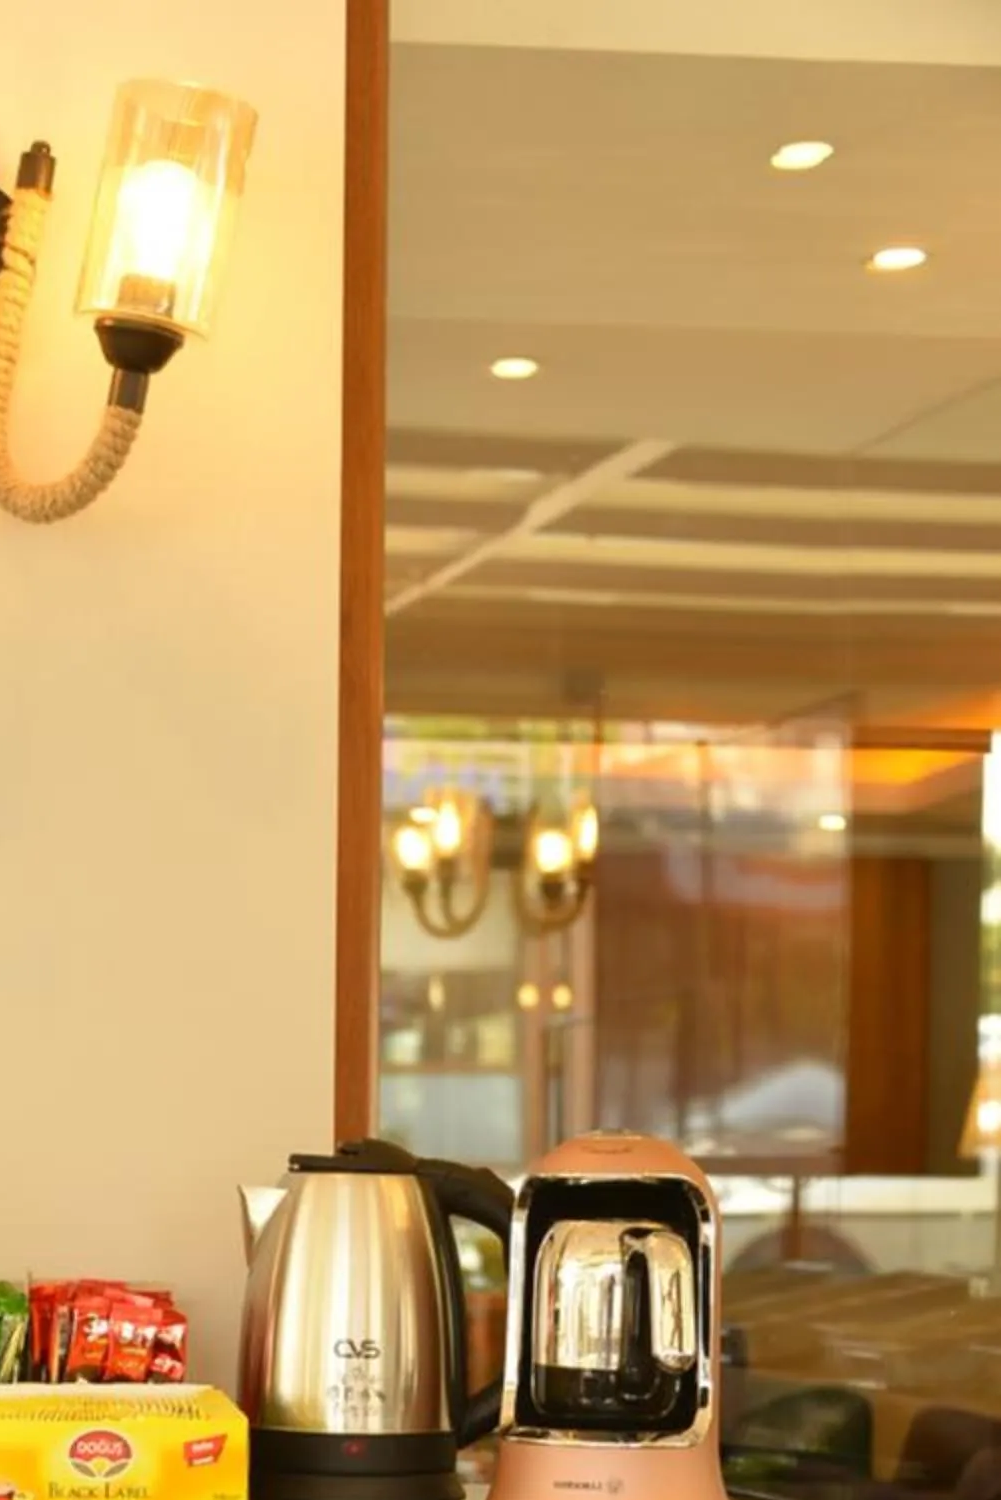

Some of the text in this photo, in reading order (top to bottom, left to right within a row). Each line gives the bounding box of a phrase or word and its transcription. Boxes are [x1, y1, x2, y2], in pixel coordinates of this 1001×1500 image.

[333, 1338, 381, 1360] CVS
[48, 1481, 150, 1499] BLACK LABEL
